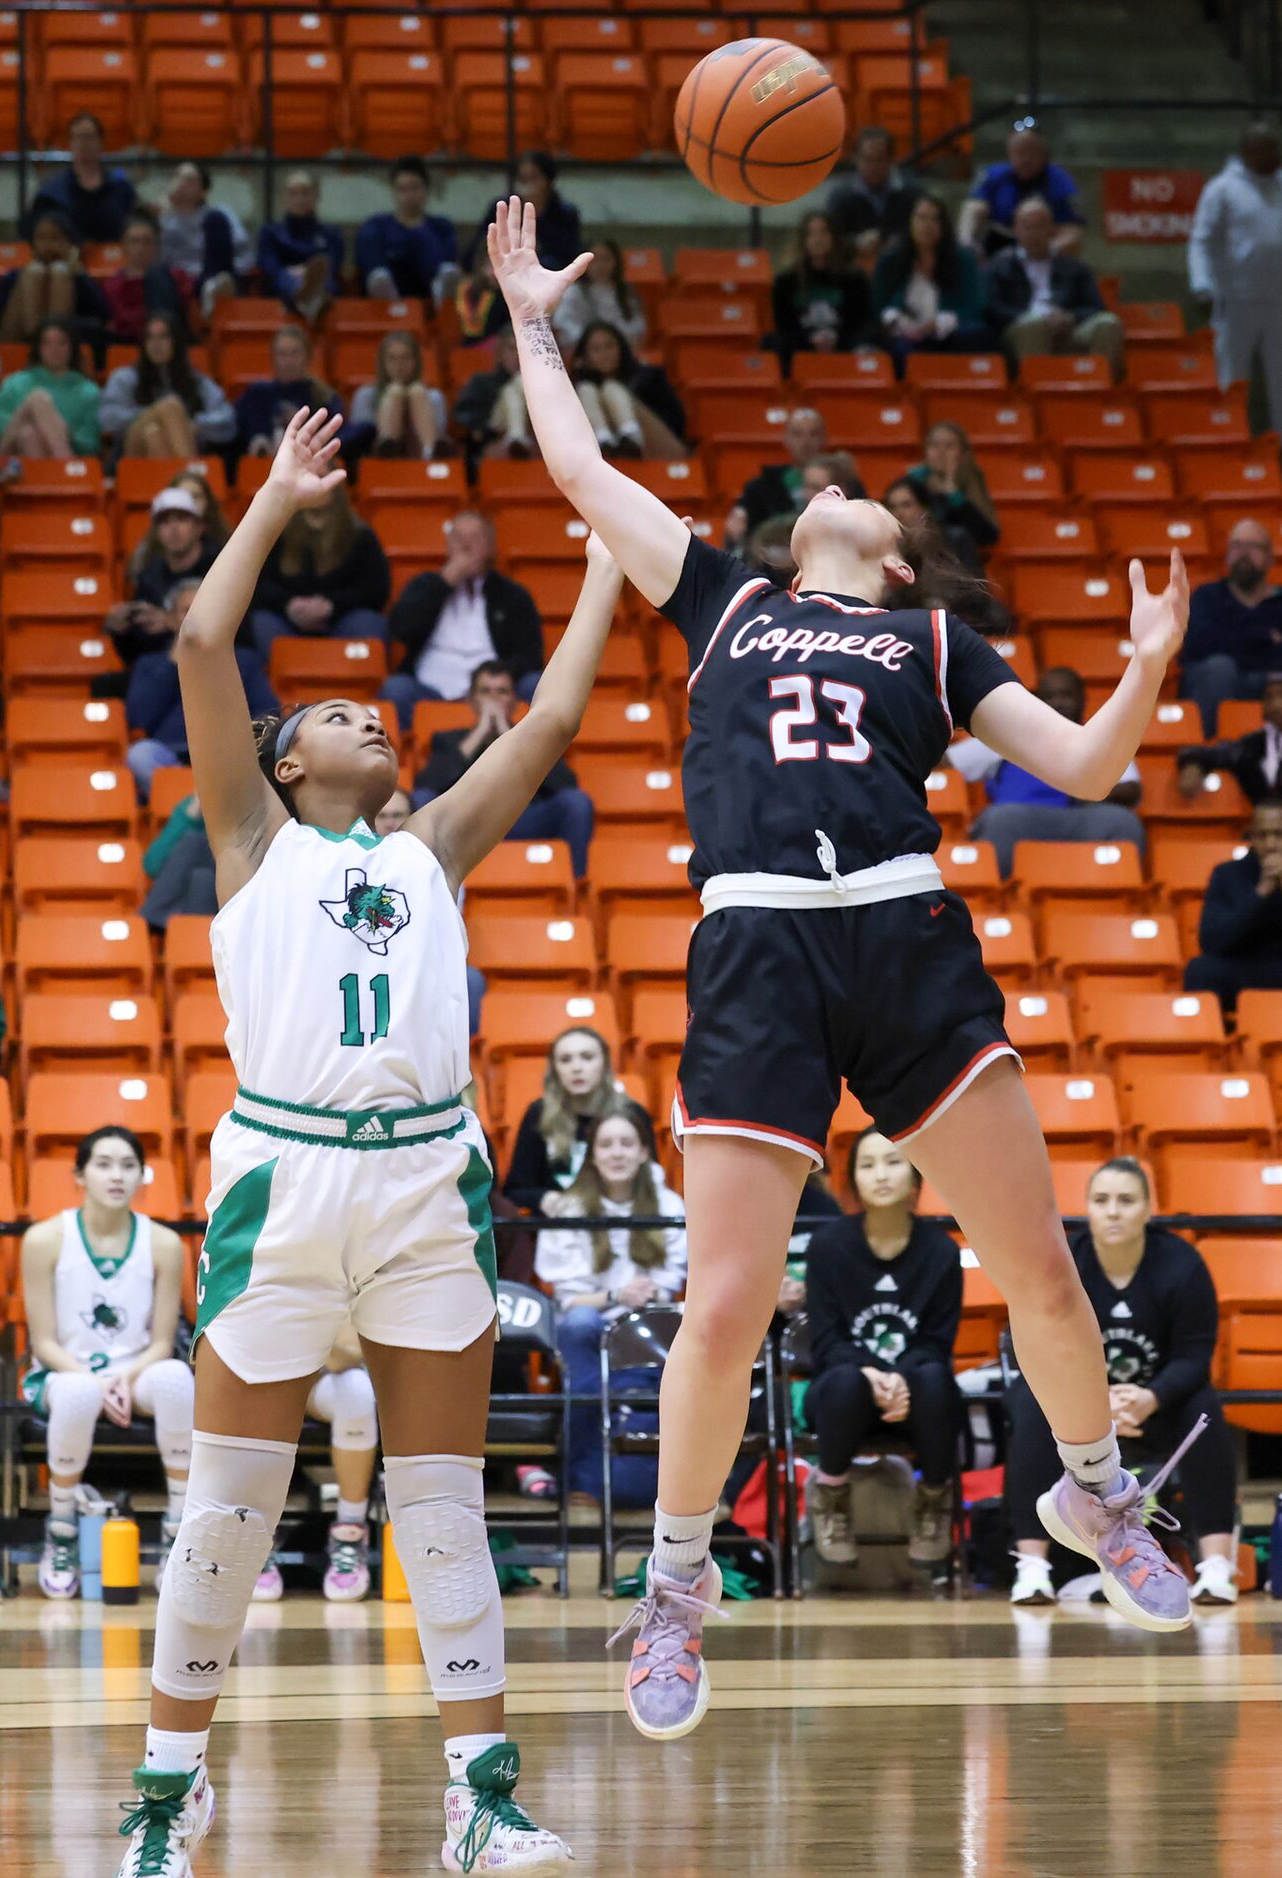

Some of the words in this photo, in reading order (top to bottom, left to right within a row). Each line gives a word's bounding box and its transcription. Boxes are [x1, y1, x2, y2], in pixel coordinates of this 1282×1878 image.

[1130, 177, 1175, 202] NO
[729, 614, 915, 672] Coppell
[768, 673, 874, 766] 23
[339, 972, 391, 1047] 11
[352, 1131, 389, 1141] adidas
